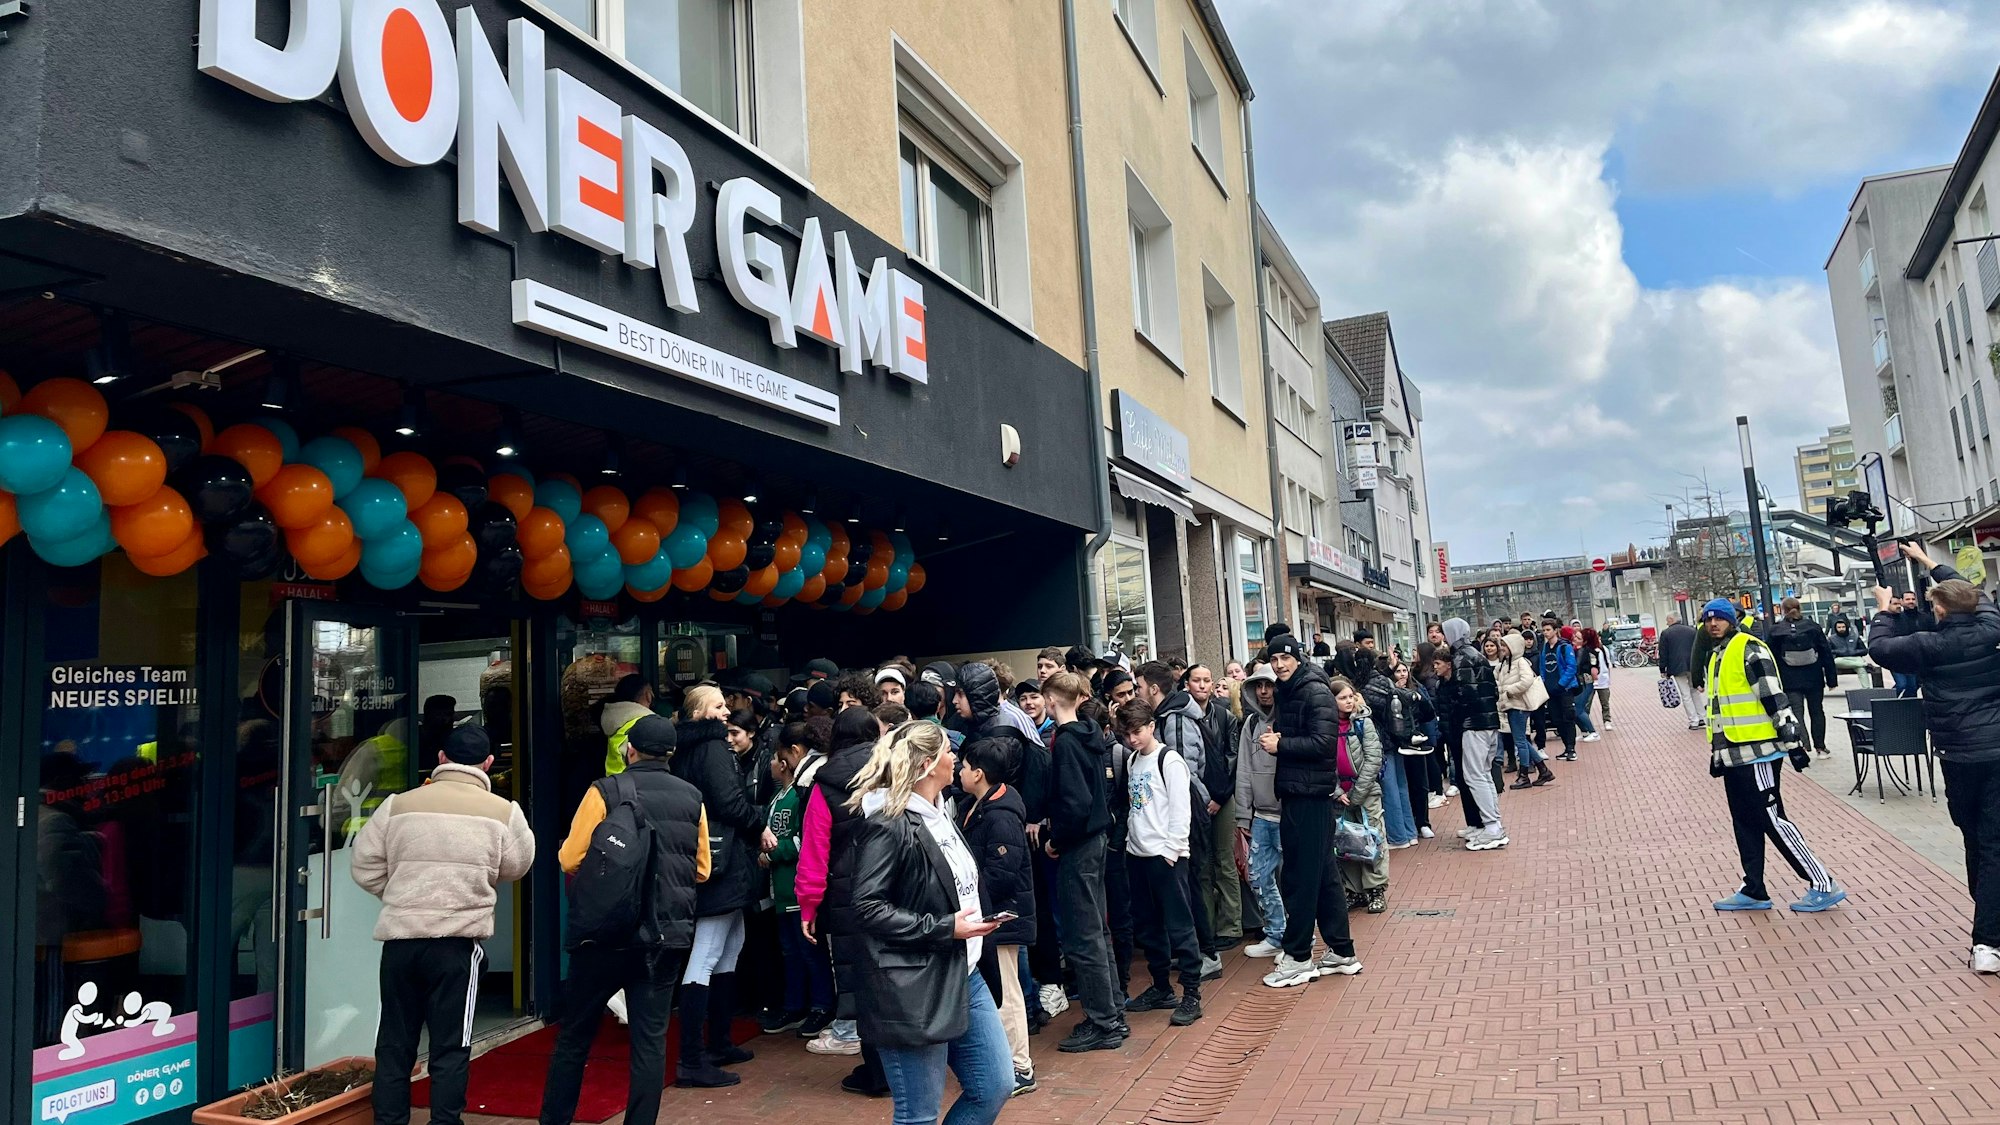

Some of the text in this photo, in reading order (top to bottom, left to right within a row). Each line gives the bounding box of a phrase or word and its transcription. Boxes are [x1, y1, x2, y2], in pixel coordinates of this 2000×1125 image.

[716, 177, 928, 385] GAME
[618, 322, 788, 401] BEST DÖNER IN THE GAME
[1433, 547, 1448, 584] wupsi
[286, 587, 323, 600] HALAL
[589, 603, 611, 614] HALAL
[51, 666, 187, 684] Gleiches Team
[51, 688, 198, 708] NEUES SPIEL!!!
[772, 808, 792, 834] SF
[162, 1058, 191, 1076] GAME
[49, 1085, 109, 1114] FOLGT UNS!
